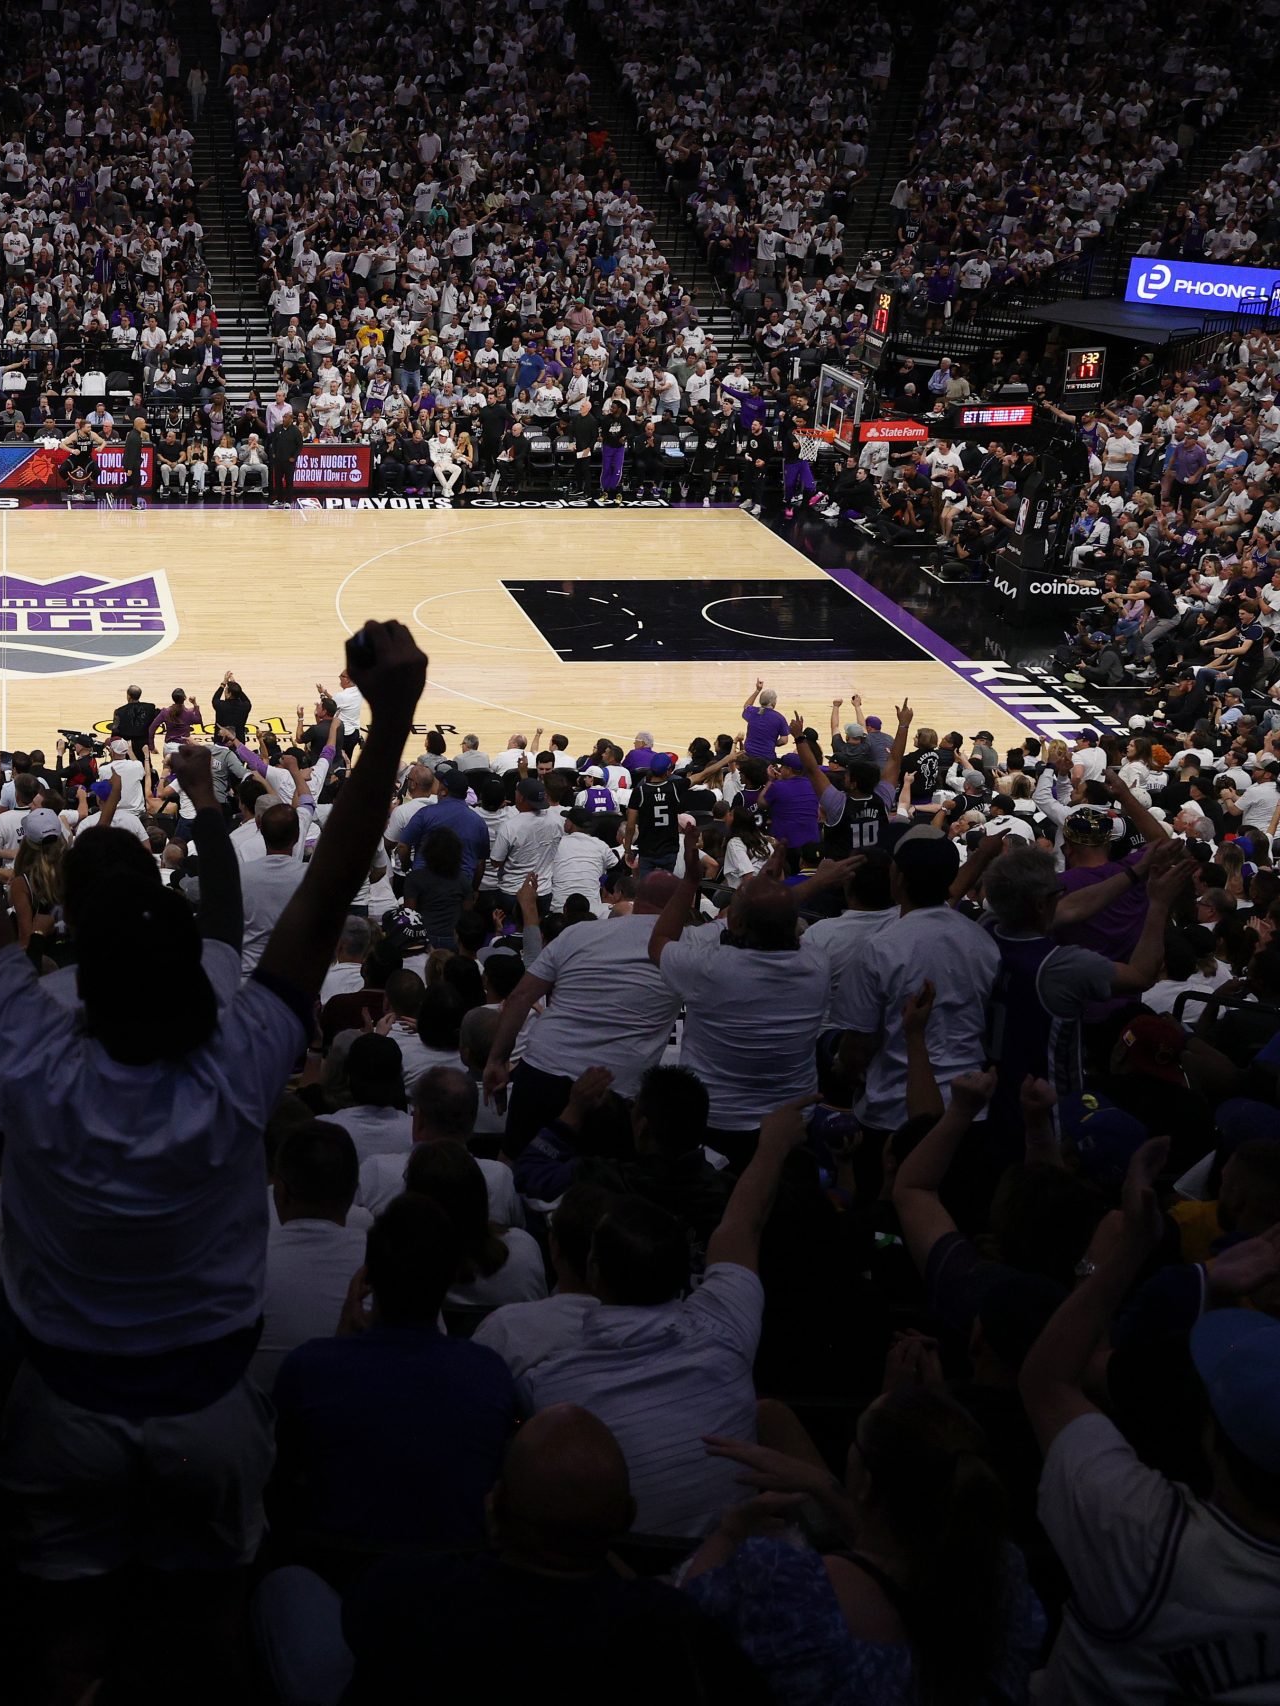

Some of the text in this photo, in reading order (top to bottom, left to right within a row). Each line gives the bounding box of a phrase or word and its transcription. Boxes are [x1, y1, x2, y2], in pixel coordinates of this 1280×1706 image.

[1174, 279, 1257, 300] PHOONG
[875, 309, 887, 333] 17
[1080, 364, 1094, 377] 17
[963, 411, 978, 424] GET
[320, 455, 358, 469] NUGGETS
[341, 471, 348, 482] ET
[325, 497, 453, 510] PLAYOFFS
[470, 499, 589, 509] Google
[653, 805, 670, 827] 5
[850, 820, 880, 849] 10
